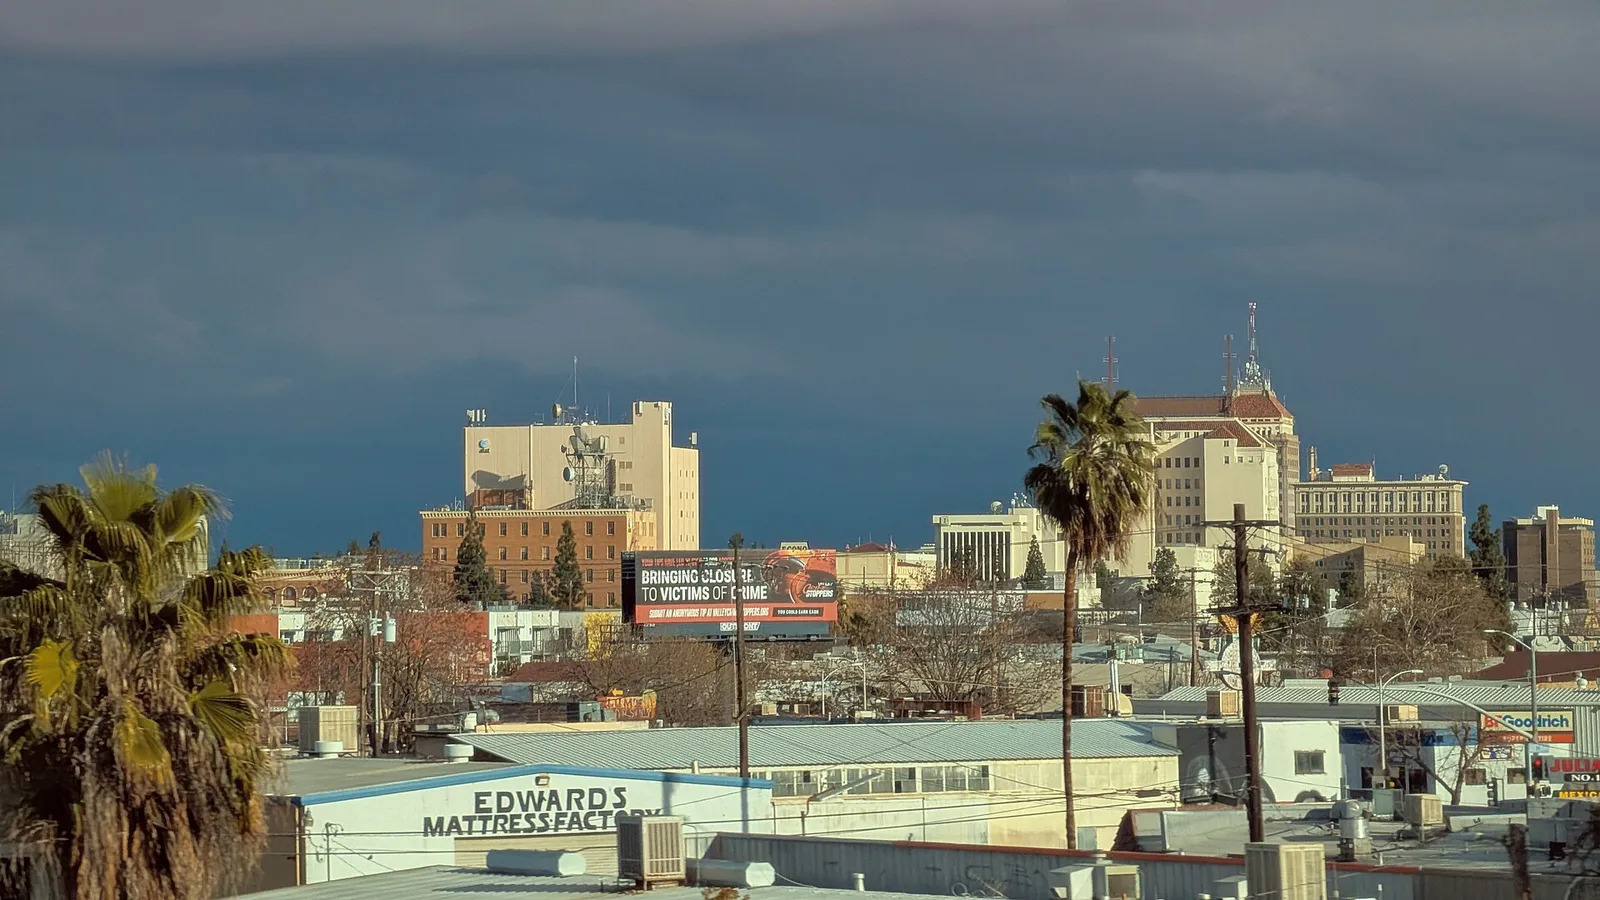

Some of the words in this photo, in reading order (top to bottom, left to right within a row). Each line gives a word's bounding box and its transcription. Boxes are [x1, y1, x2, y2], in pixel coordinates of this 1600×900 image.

[641, 569, 698, 585] BRINGING
[642, 587, 658, 602] TO
[661, 586, 709, 601] VICTIMS
[712, 585, 728, 600] OF
[731, 585, 768, 600] CRIME
[805, 589, 834, 598] STOPPERS
[720, 622, 760, 631] OUTONT
[474, 787, 627, 814] EDWARDS
[1559, 791, 1600, 799] MEXIC
[423, 813, 549, 837] MATTRESS
[553, 808, 662, 832] FACT
